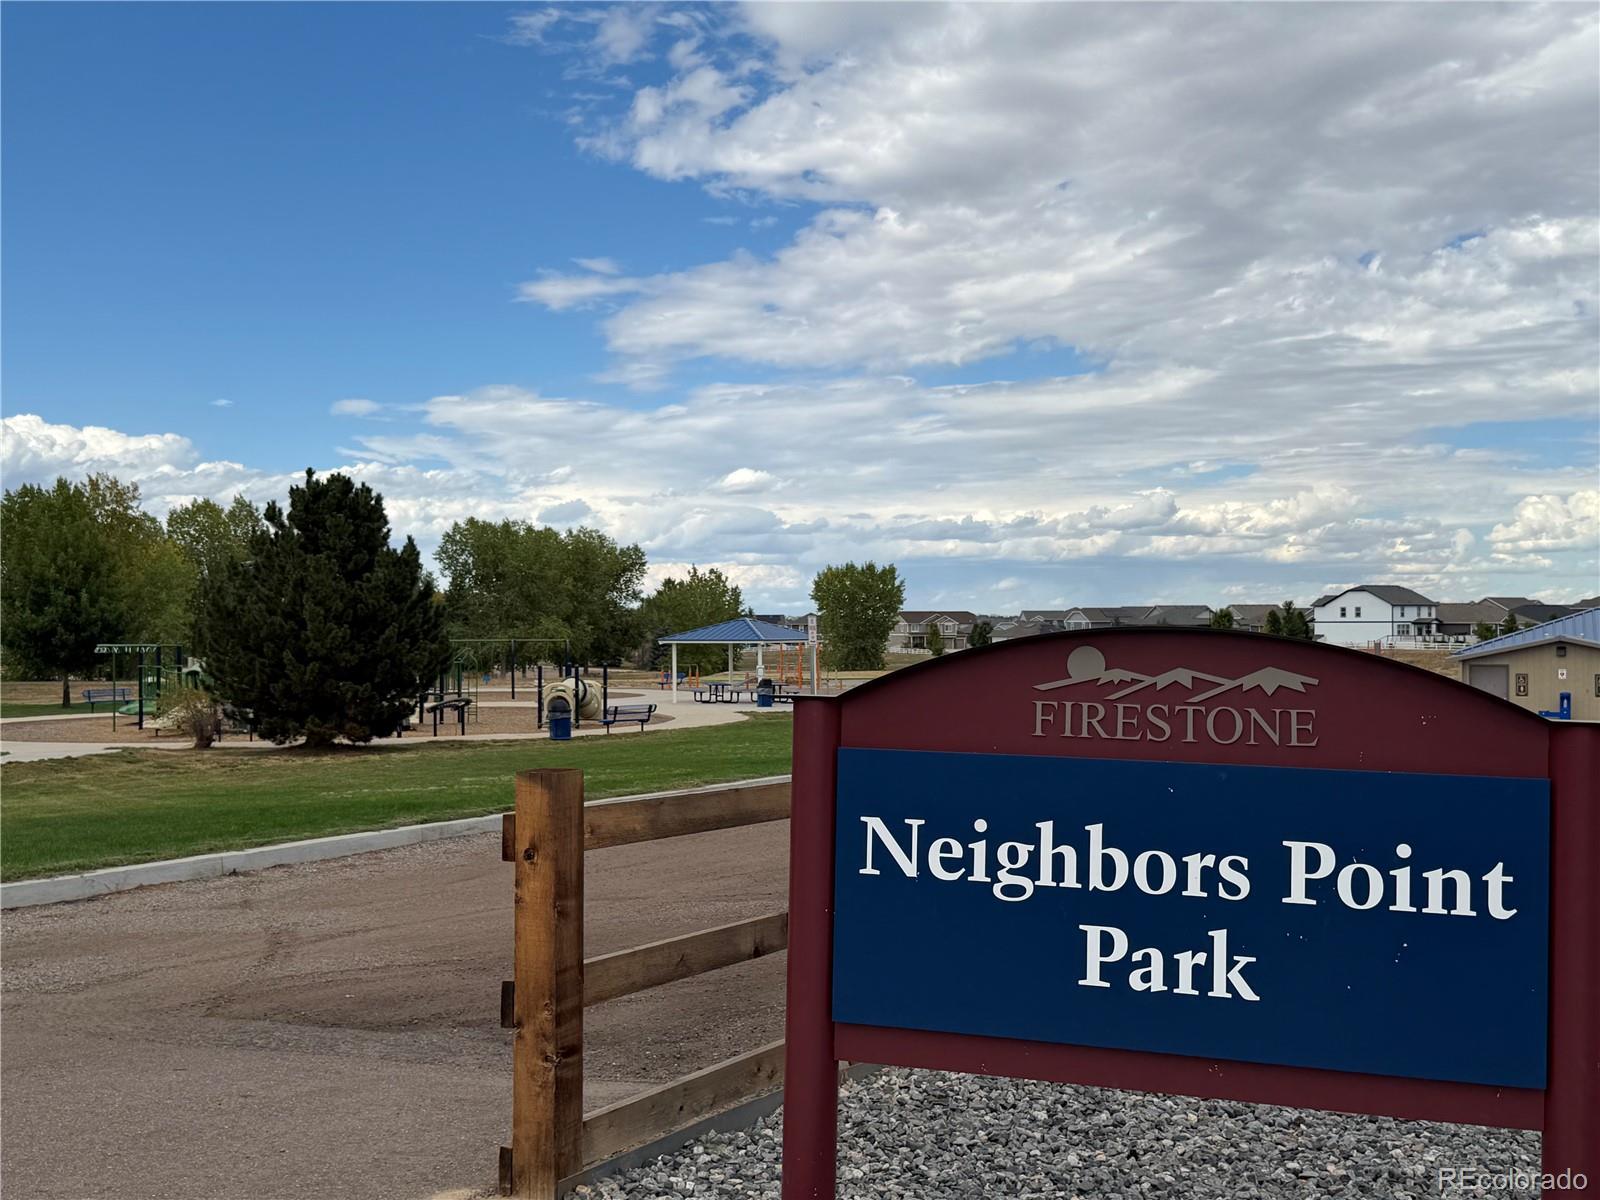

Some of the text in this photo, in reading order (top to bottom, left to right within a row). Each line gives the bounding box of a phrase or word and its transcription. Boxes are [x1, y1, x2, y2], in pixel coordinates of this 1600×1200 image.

[1032, 700, 1319, 748] FIRESTONE
[859, 816, 1517, 920] Neighbors Point
[1078, 924, 1260, 1001] Park
